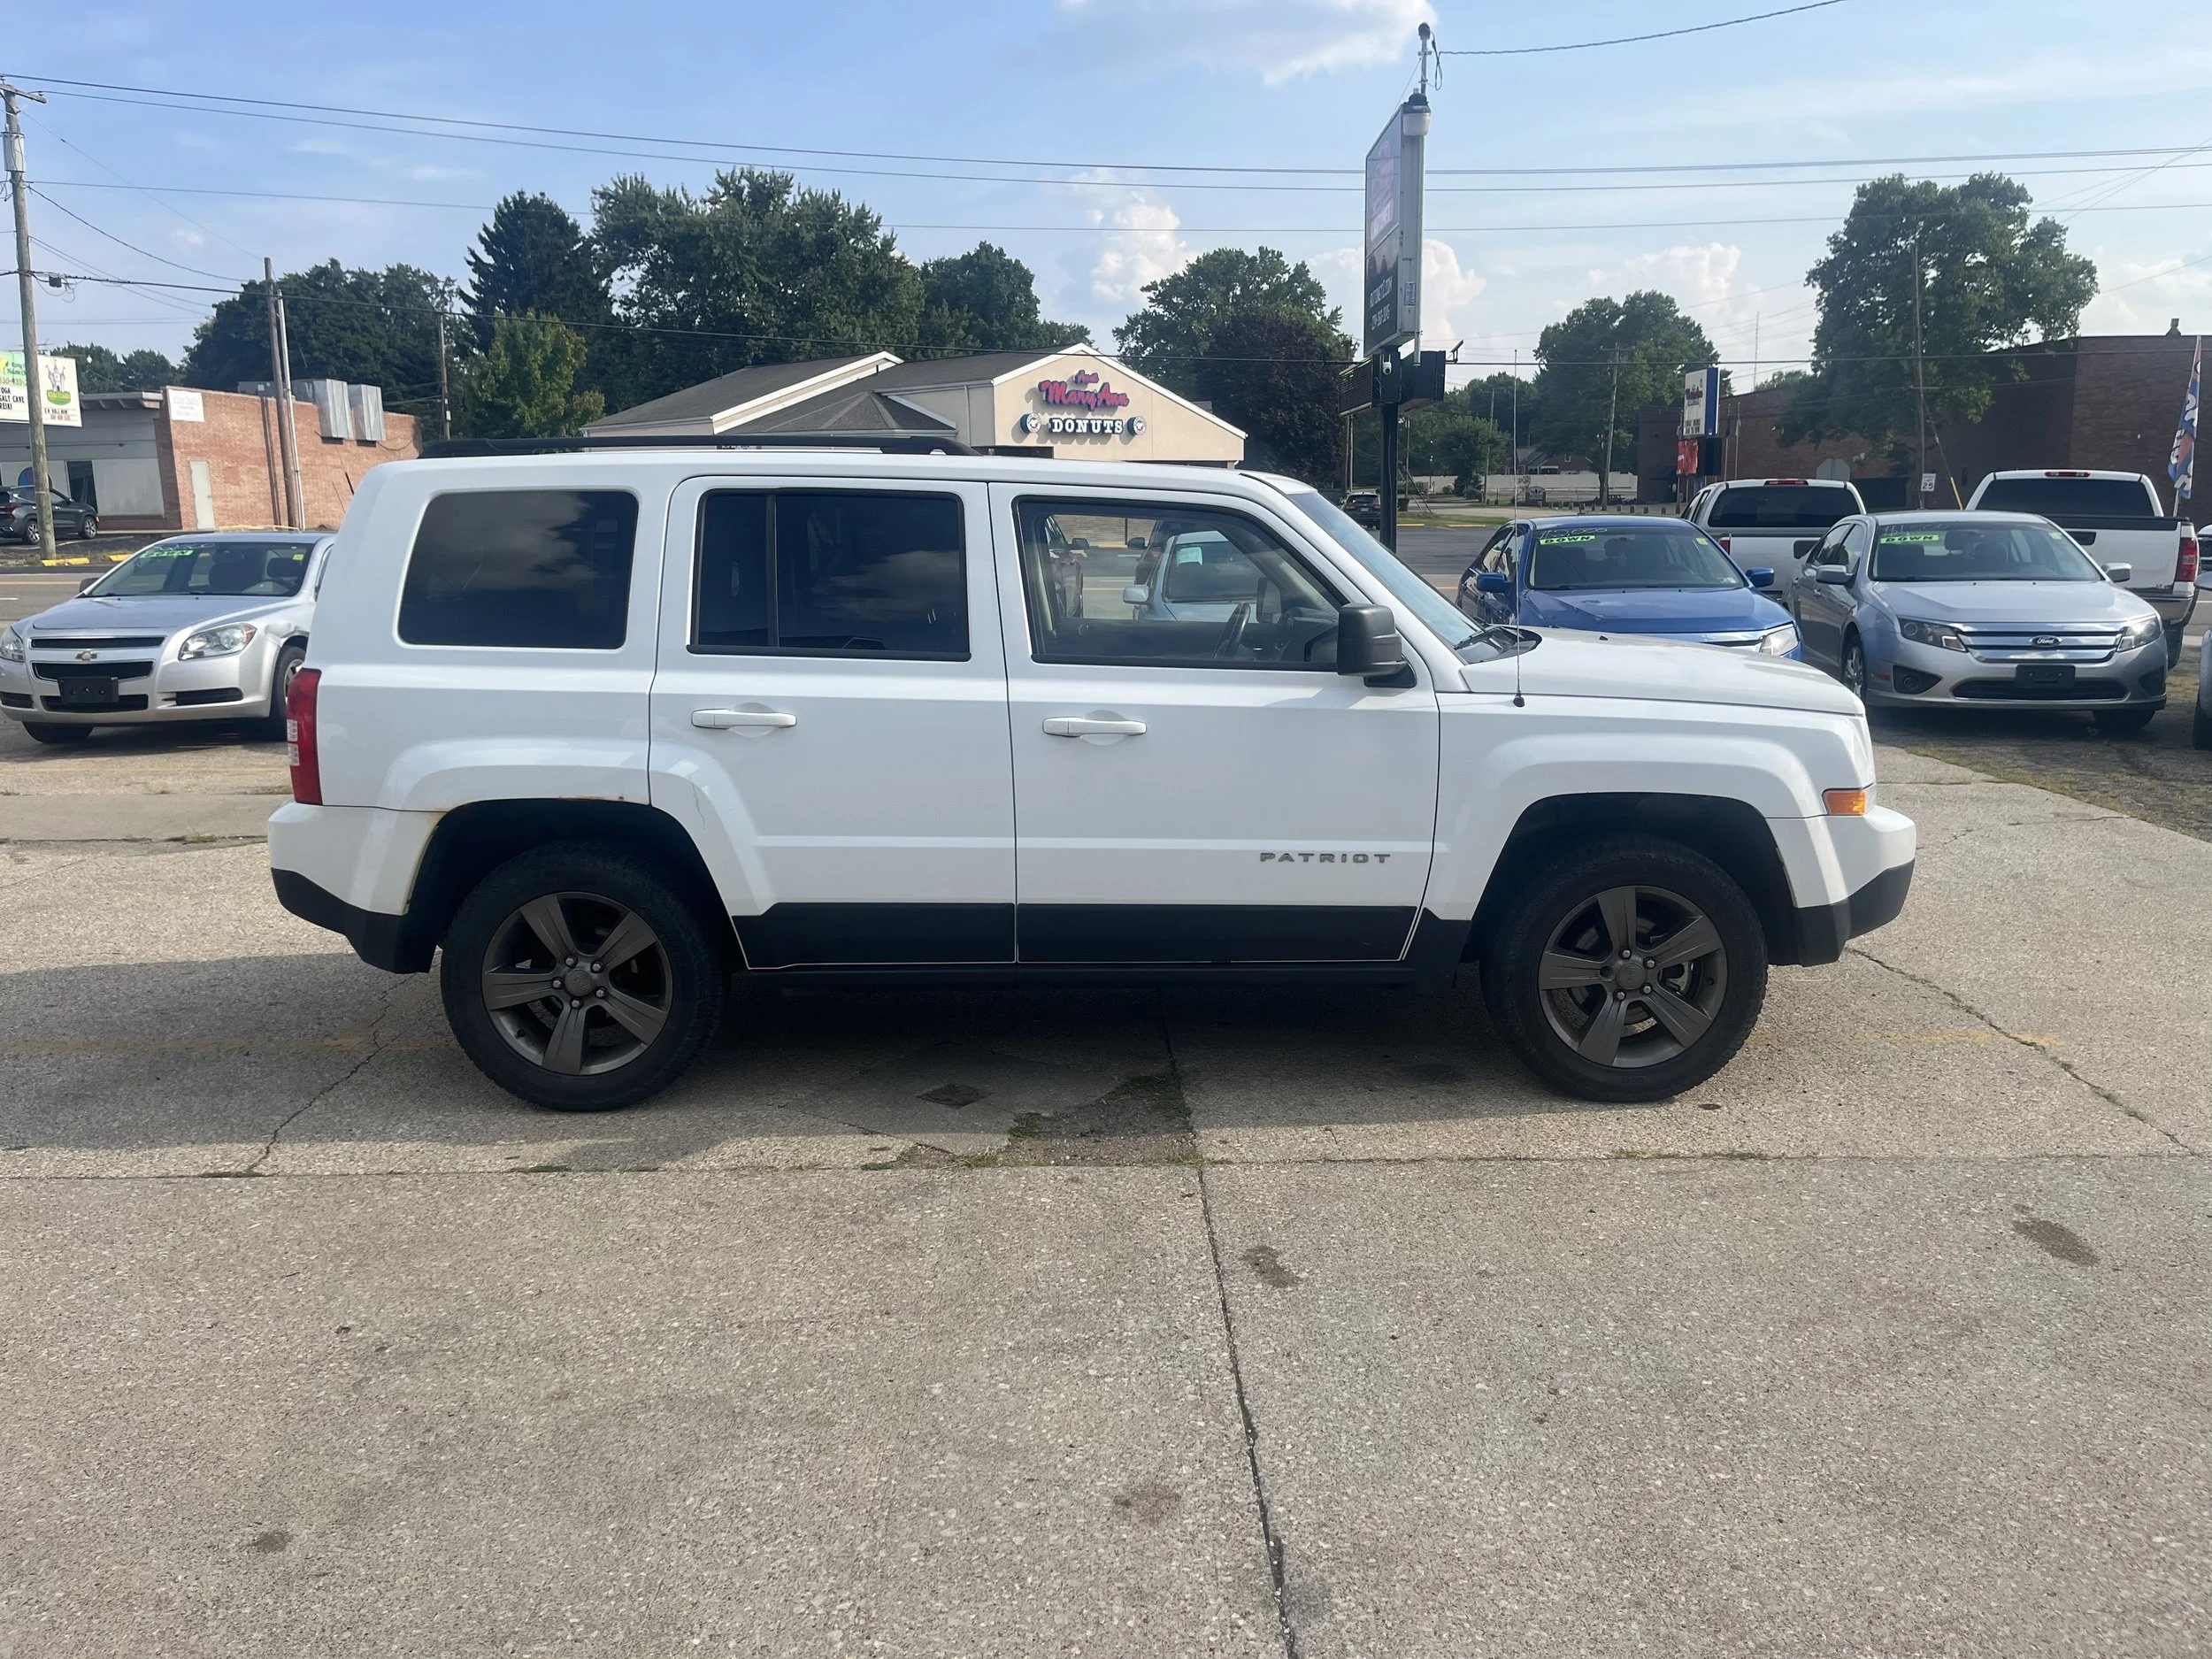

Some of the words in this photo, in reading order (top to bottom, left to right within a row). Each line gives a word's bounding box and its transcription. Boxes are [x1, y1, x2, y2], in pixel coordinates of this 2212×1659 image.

[1039, 380, 1095, 411] Mary
[1096, 382, 1130, 407] Ann
[1050, 418, 1124, 434] DONUTS
[1260, 852, 1391, 864] PATRIOT
